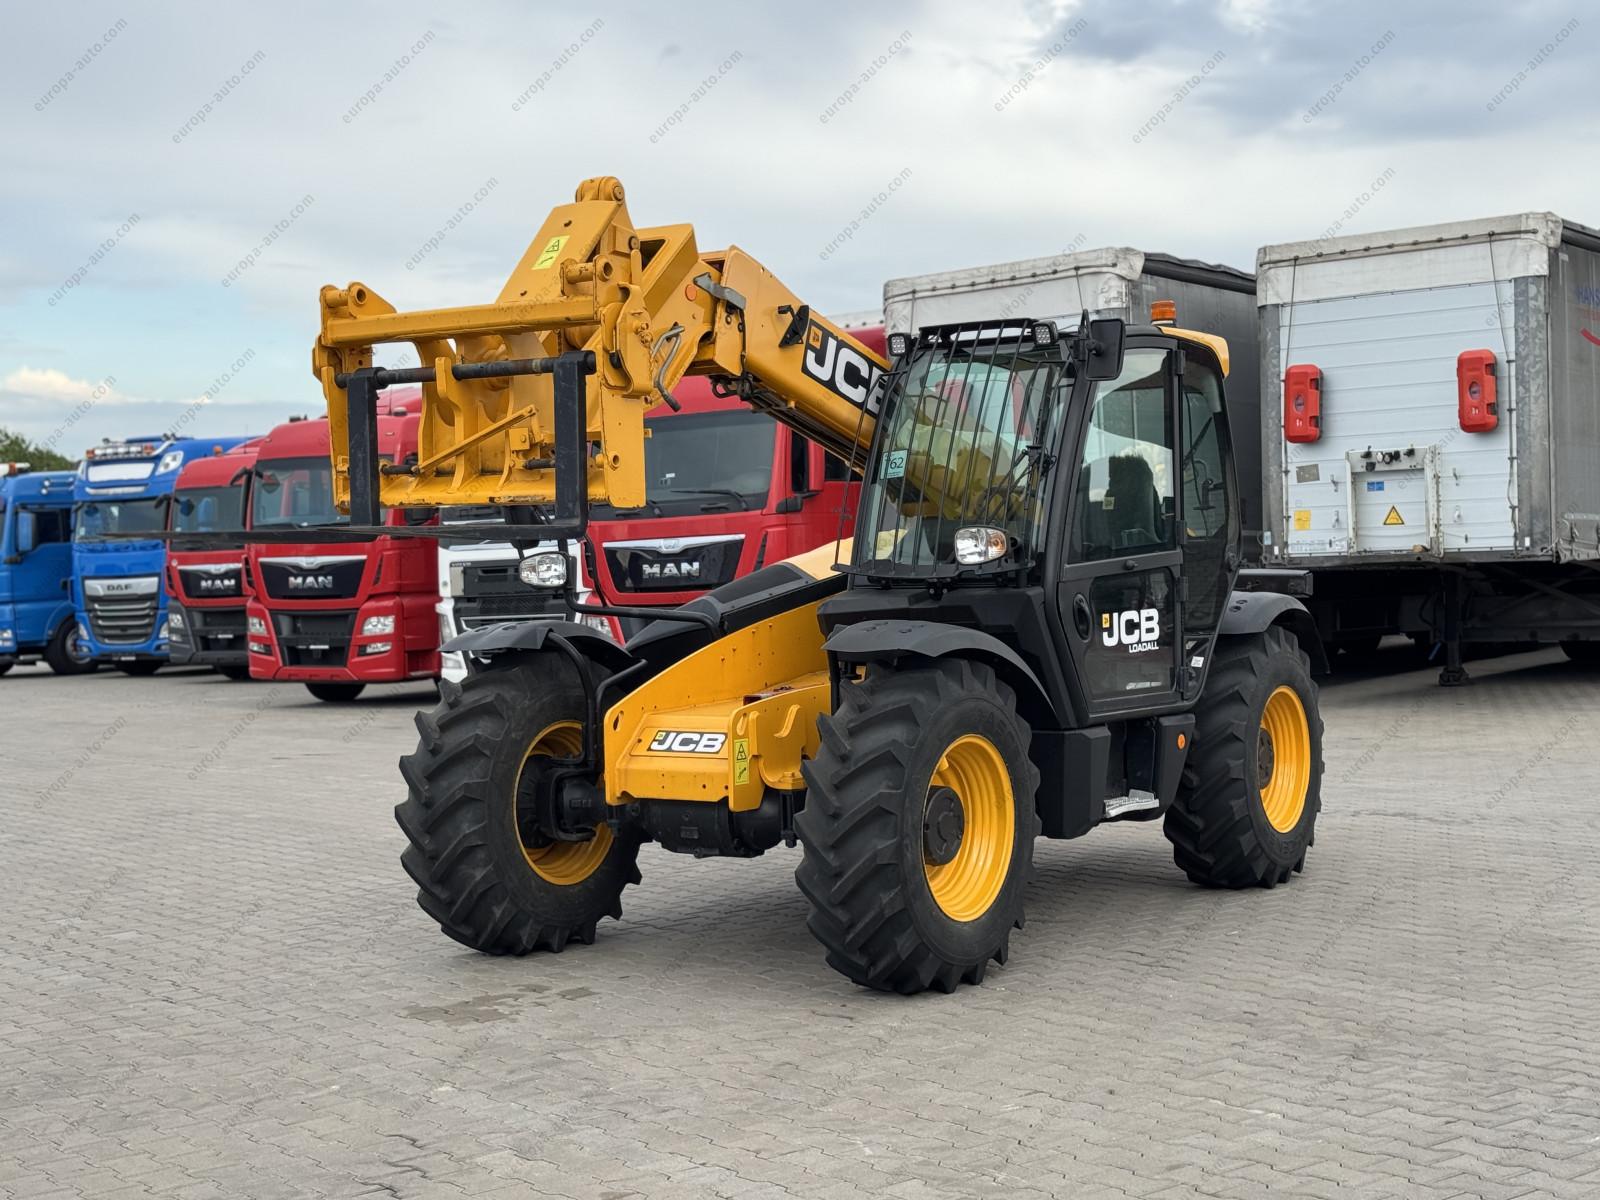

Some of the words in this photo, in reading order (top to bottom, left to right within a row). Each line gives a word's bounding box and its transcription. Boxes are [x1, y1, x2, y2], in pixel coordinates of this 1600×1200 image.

[642, 562, 700, 578] MAN
[106, 583, 132, 591] DAF
[200, 579, 235, 590] MAN
[288, 575, 333, 589] MAN
[1102, 608, 1160, 647] JCB
[1128, 641, 1159, 653] LOADALL
[650, 732, 726, 753] JCB
